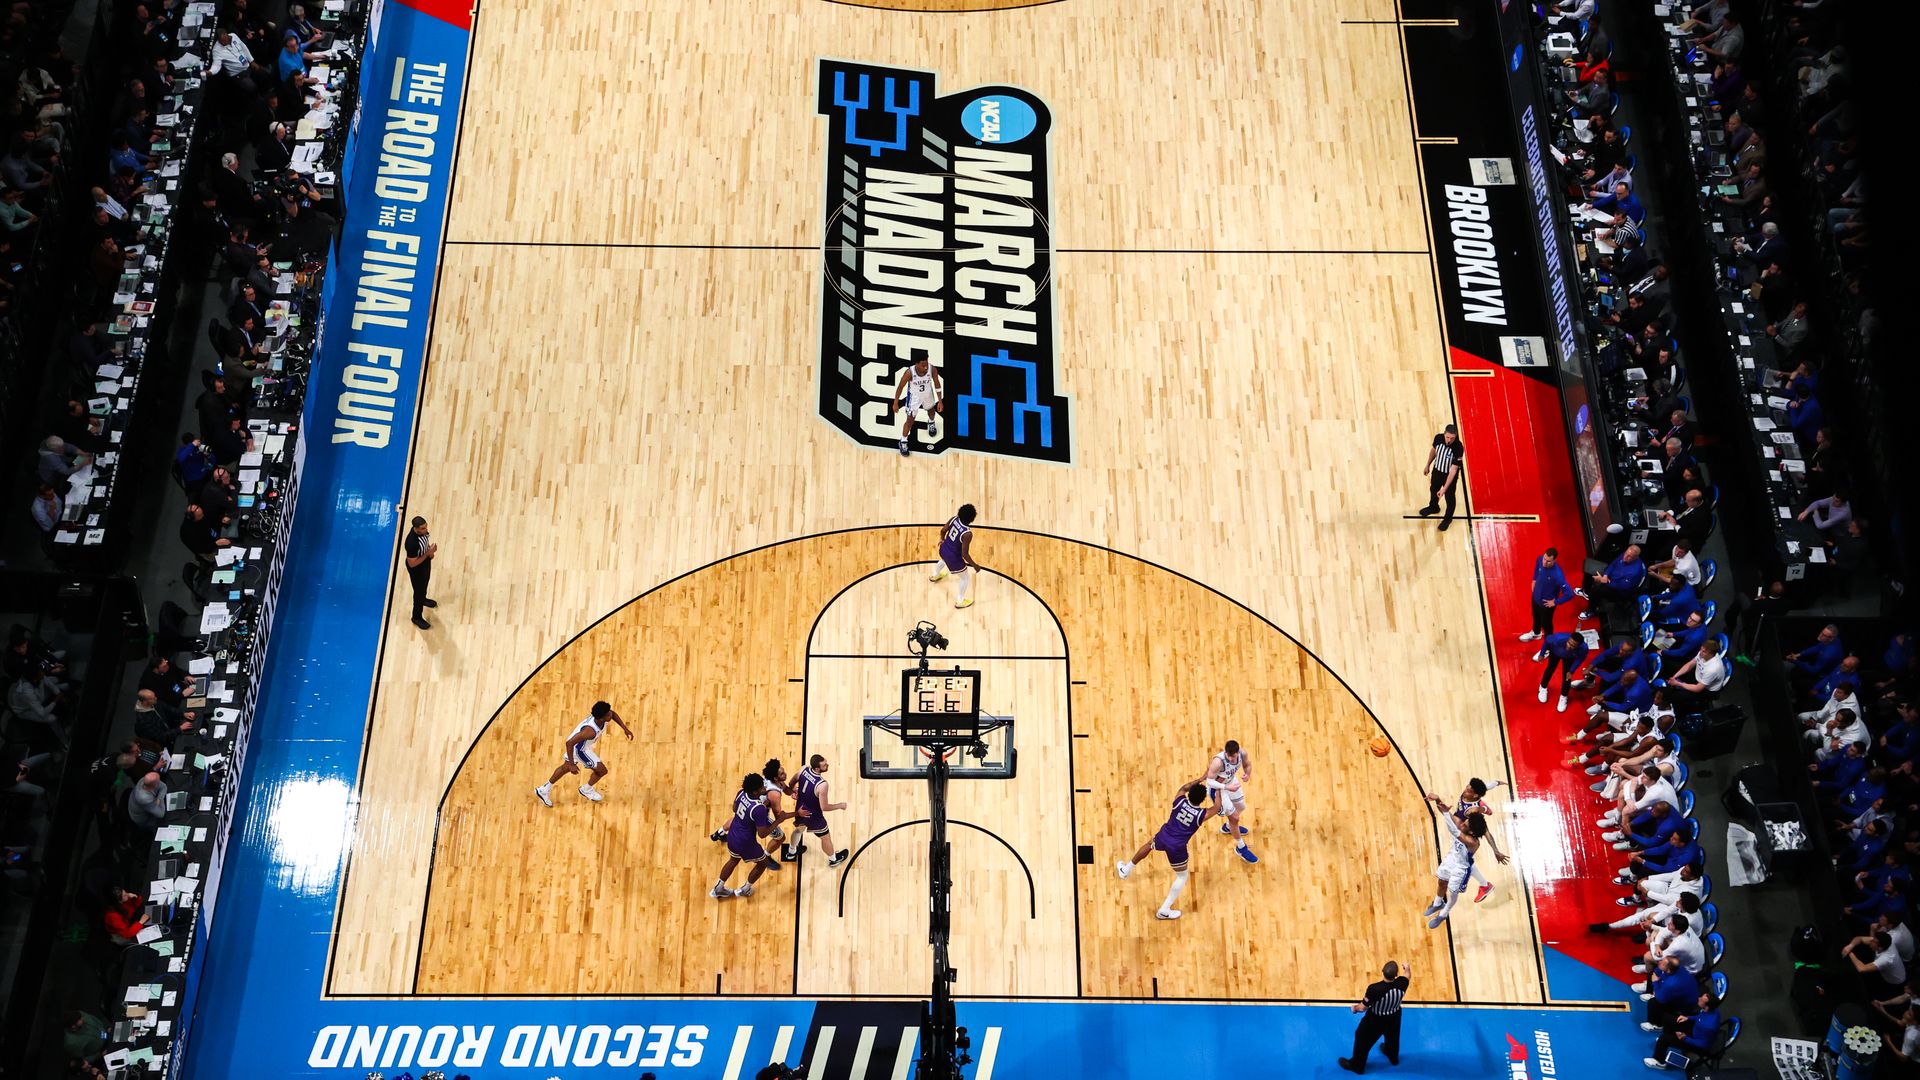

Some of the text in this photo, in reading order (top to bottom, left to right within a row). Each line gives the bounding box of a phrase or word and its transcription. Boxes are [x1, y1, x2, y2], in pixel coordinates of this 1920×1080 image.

[980, 100, 1000, 142] NCAA
[331, 63, 447, 449] THE ROAD TO THE FINAL FOUR
[954, 145, 1038, 346] MARCH
[1444, 184, 1508, 326] BROOKLYN
[1521, 104, 1576, 363] CELEBRATES STUDENT-ATHLETES
[859, 167, 944, 445] MADNESS
[802, 780, 809, 793] 1
[1175, 808, 1195, 827] 22
[307, 1024, 710, 1068] SECOND ROUND
[1534, 1030, 1556, 1075] HOSTED
